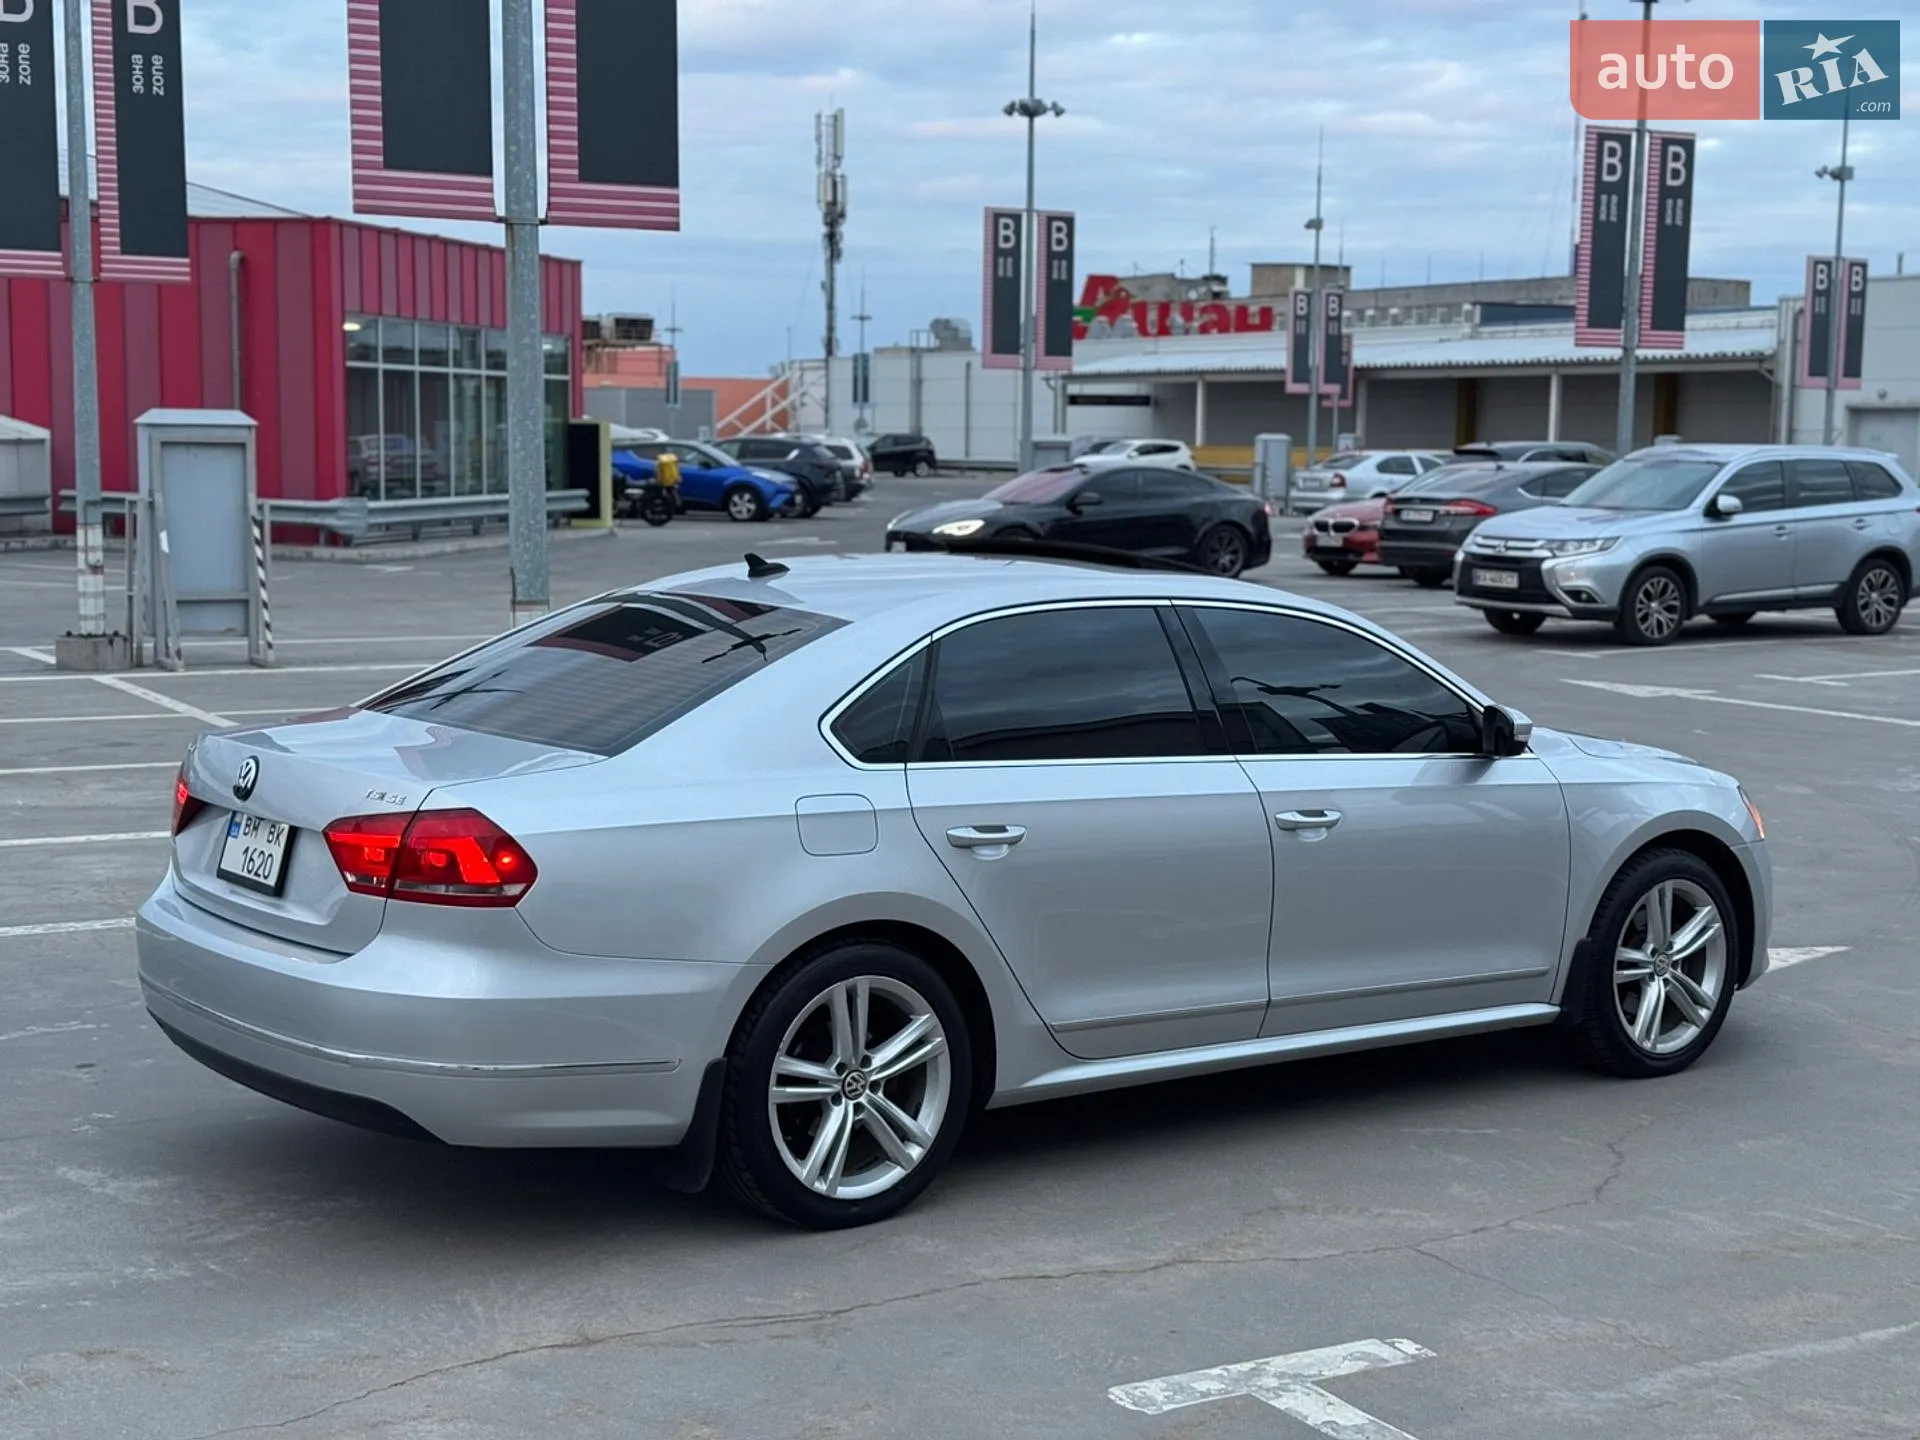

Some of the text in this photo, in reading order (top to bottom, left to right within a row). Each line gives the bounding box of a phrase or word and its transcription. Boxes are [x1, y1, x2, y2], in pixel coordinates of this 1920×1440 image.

[18, 43, 31, 85] zone
[131, 54, 144, 94] зона
[152, 55, 165, 96] zone
[1602, 140, 1622, 182] B
[1665, 145, 1686, 186] B
[998, 217, 1016, 249] B
[1050, 220, 1069, 252] B
[1815, 263, 1828, 290] B
[1850, 265, 1864, 292] B
[266, 823, 285, 847] BK
[241, 845, 275, 880] 1620
